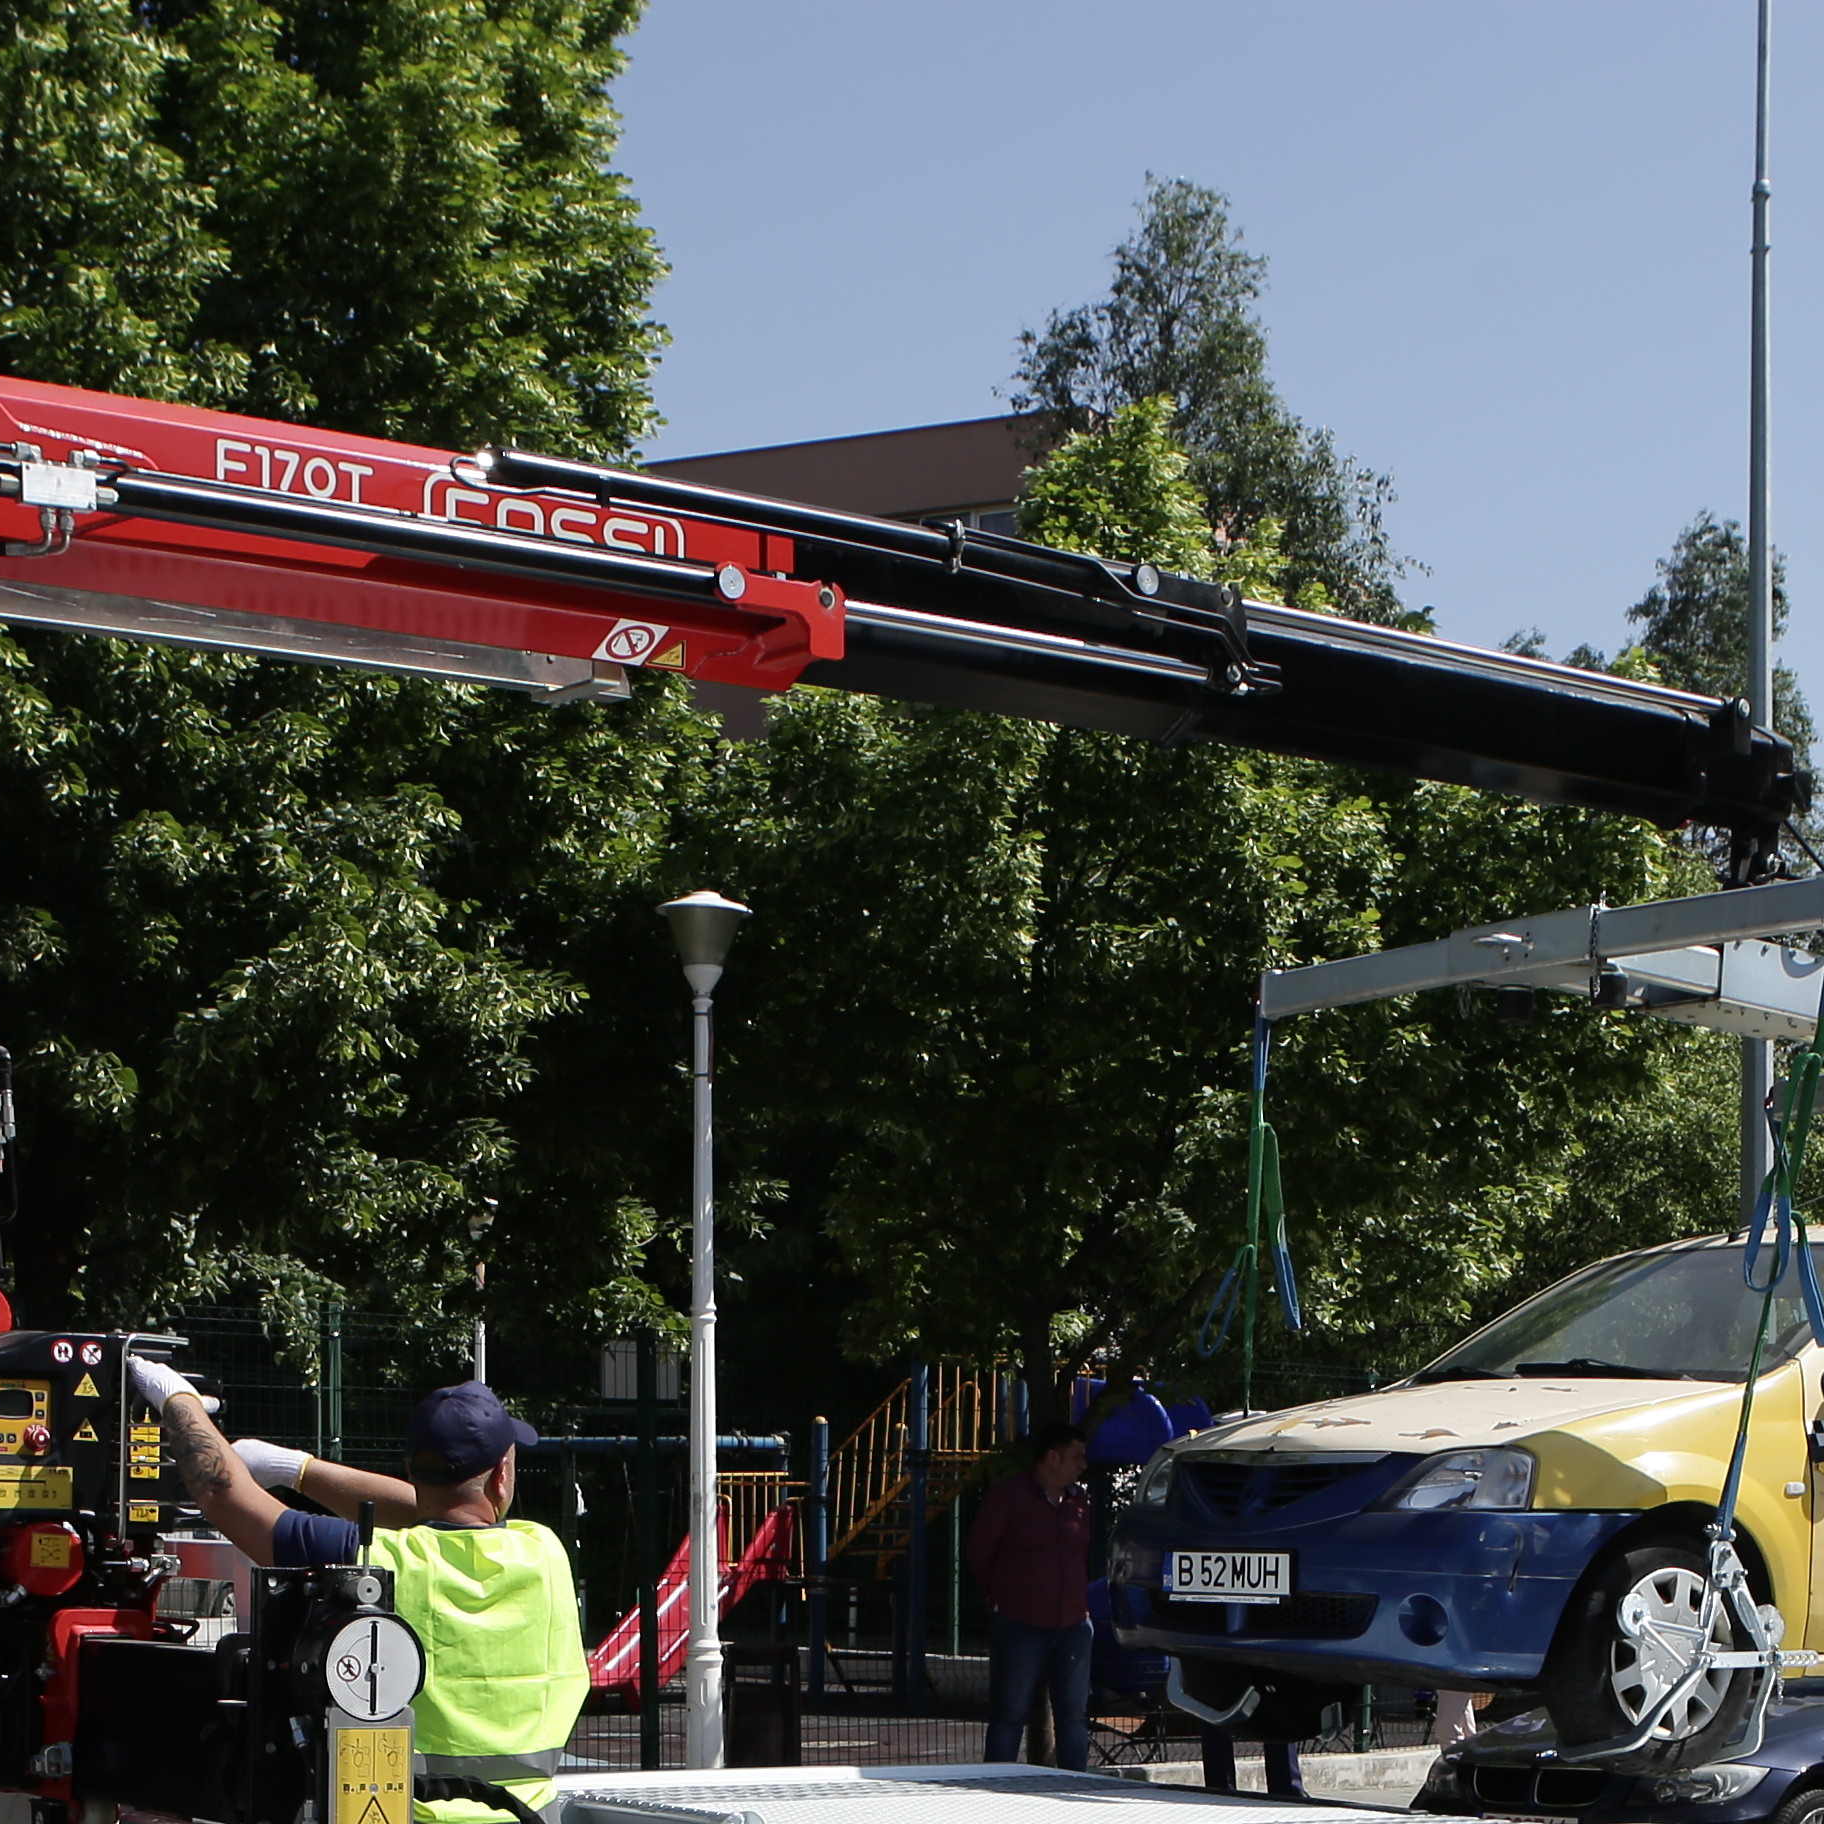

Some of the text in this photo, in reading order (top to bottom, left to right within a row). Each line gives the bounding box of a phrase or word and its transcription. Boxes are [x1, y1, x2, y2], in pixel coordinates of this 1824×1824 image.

[216, 438, 374, 503] F170T
[1179, 1555, 1279, 1589] B 52 MUH
